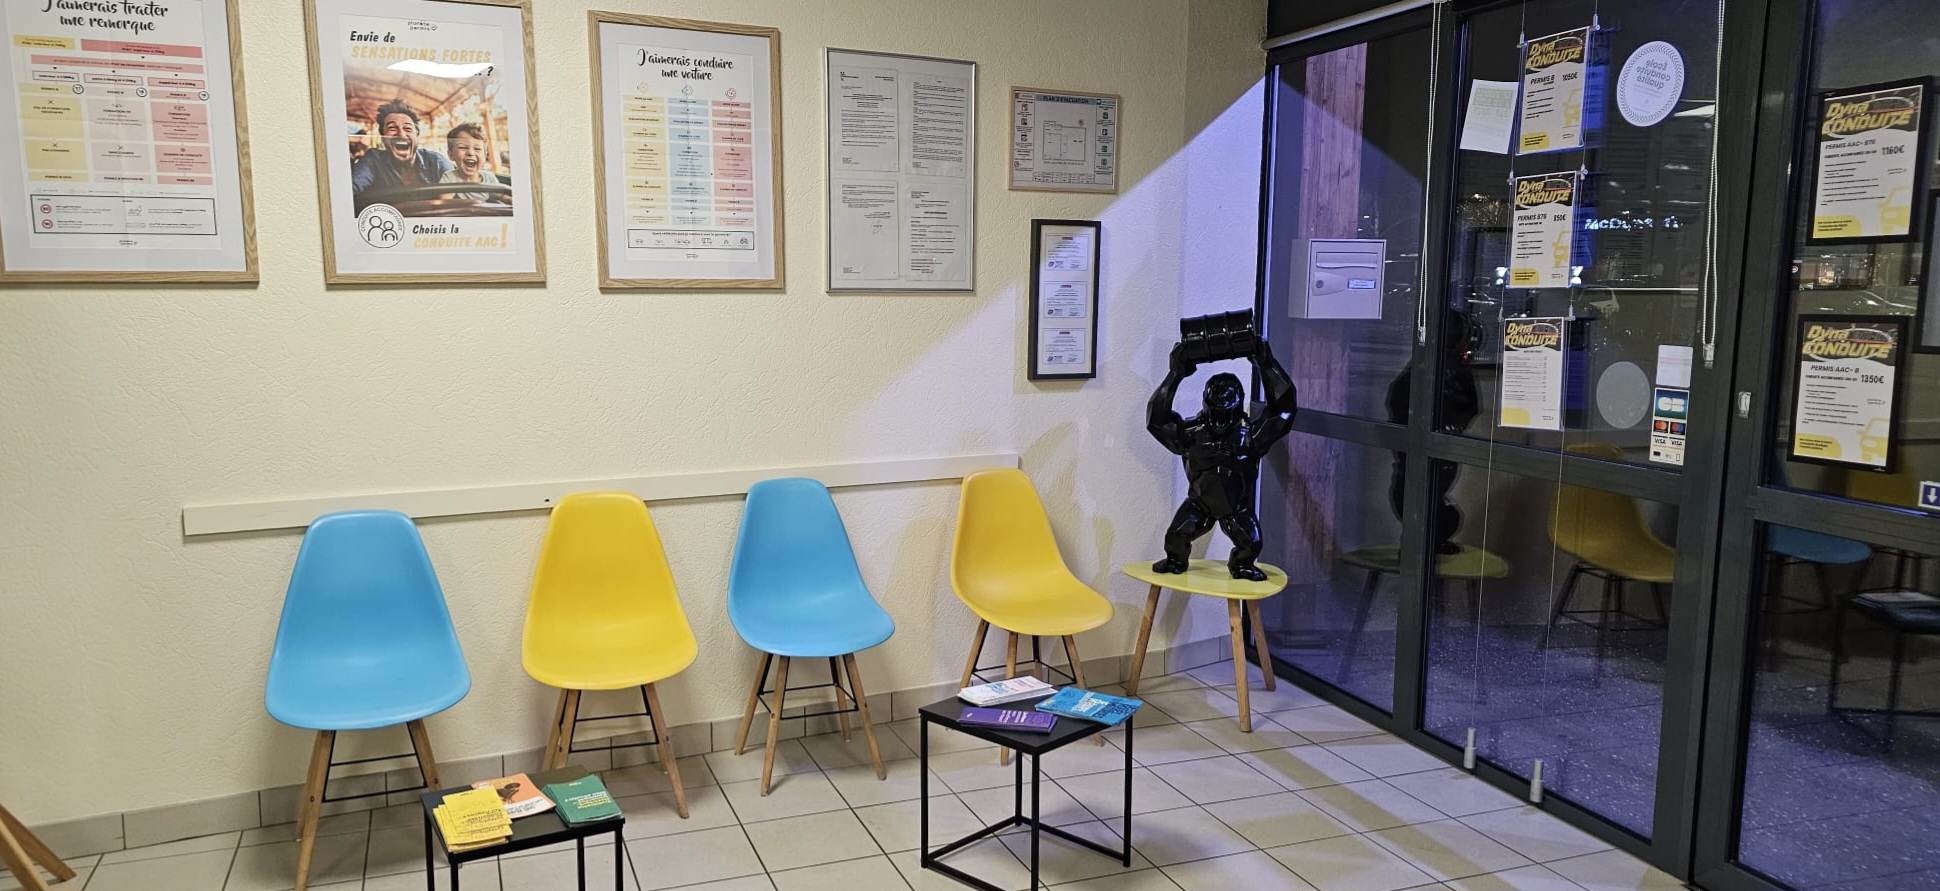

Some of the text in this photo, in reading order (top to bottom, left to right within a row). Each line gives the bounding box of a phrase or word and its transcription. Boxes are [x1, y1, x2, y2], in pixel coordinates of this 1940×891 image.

[41, 0, 169, 17] Jaimerais tracter
[59, 16, 155, 35] une remorque
[350, 31, 396, 43] Envie de
[351, 45, 492, 63] SENSATIONS FORTES
[1529, 41, 1556, 57] Dyna
[637, 48, 734, 70] J'aimerais conduire
[1525, 46, 1583, 69] CONDUITE
[661, 67, 713, 81] une voiture
[1530, 75, 1551, 85] PERMIS
[1826, 100, 1870, 120] Dyna
[1821, 109, 1913, 134] CONDUITE
[1825, 142, 1846, 150] PERMIS
[1881, 145, 1905, 155] 1160€
[1518, 181, 1545, 193] Dyna
[1515, 189, 1572, 205] CONDUITE
[412, 223, 459, 234] Choisis la
[413, 236, 472, 249] CONDUITE
[1507, 322, 1534, 335] Dyna
[1806, 325, 1850, 341] Dyna
[1504, 334, 1559, 346] CONDUITE
[1802, 341, 1893, 359] CONDUITE
[1810, 364, 1834, 372] PERMIS
[1860, 374, 1885, 384] 1350€
[1657, 396, 1685, 412] CB
